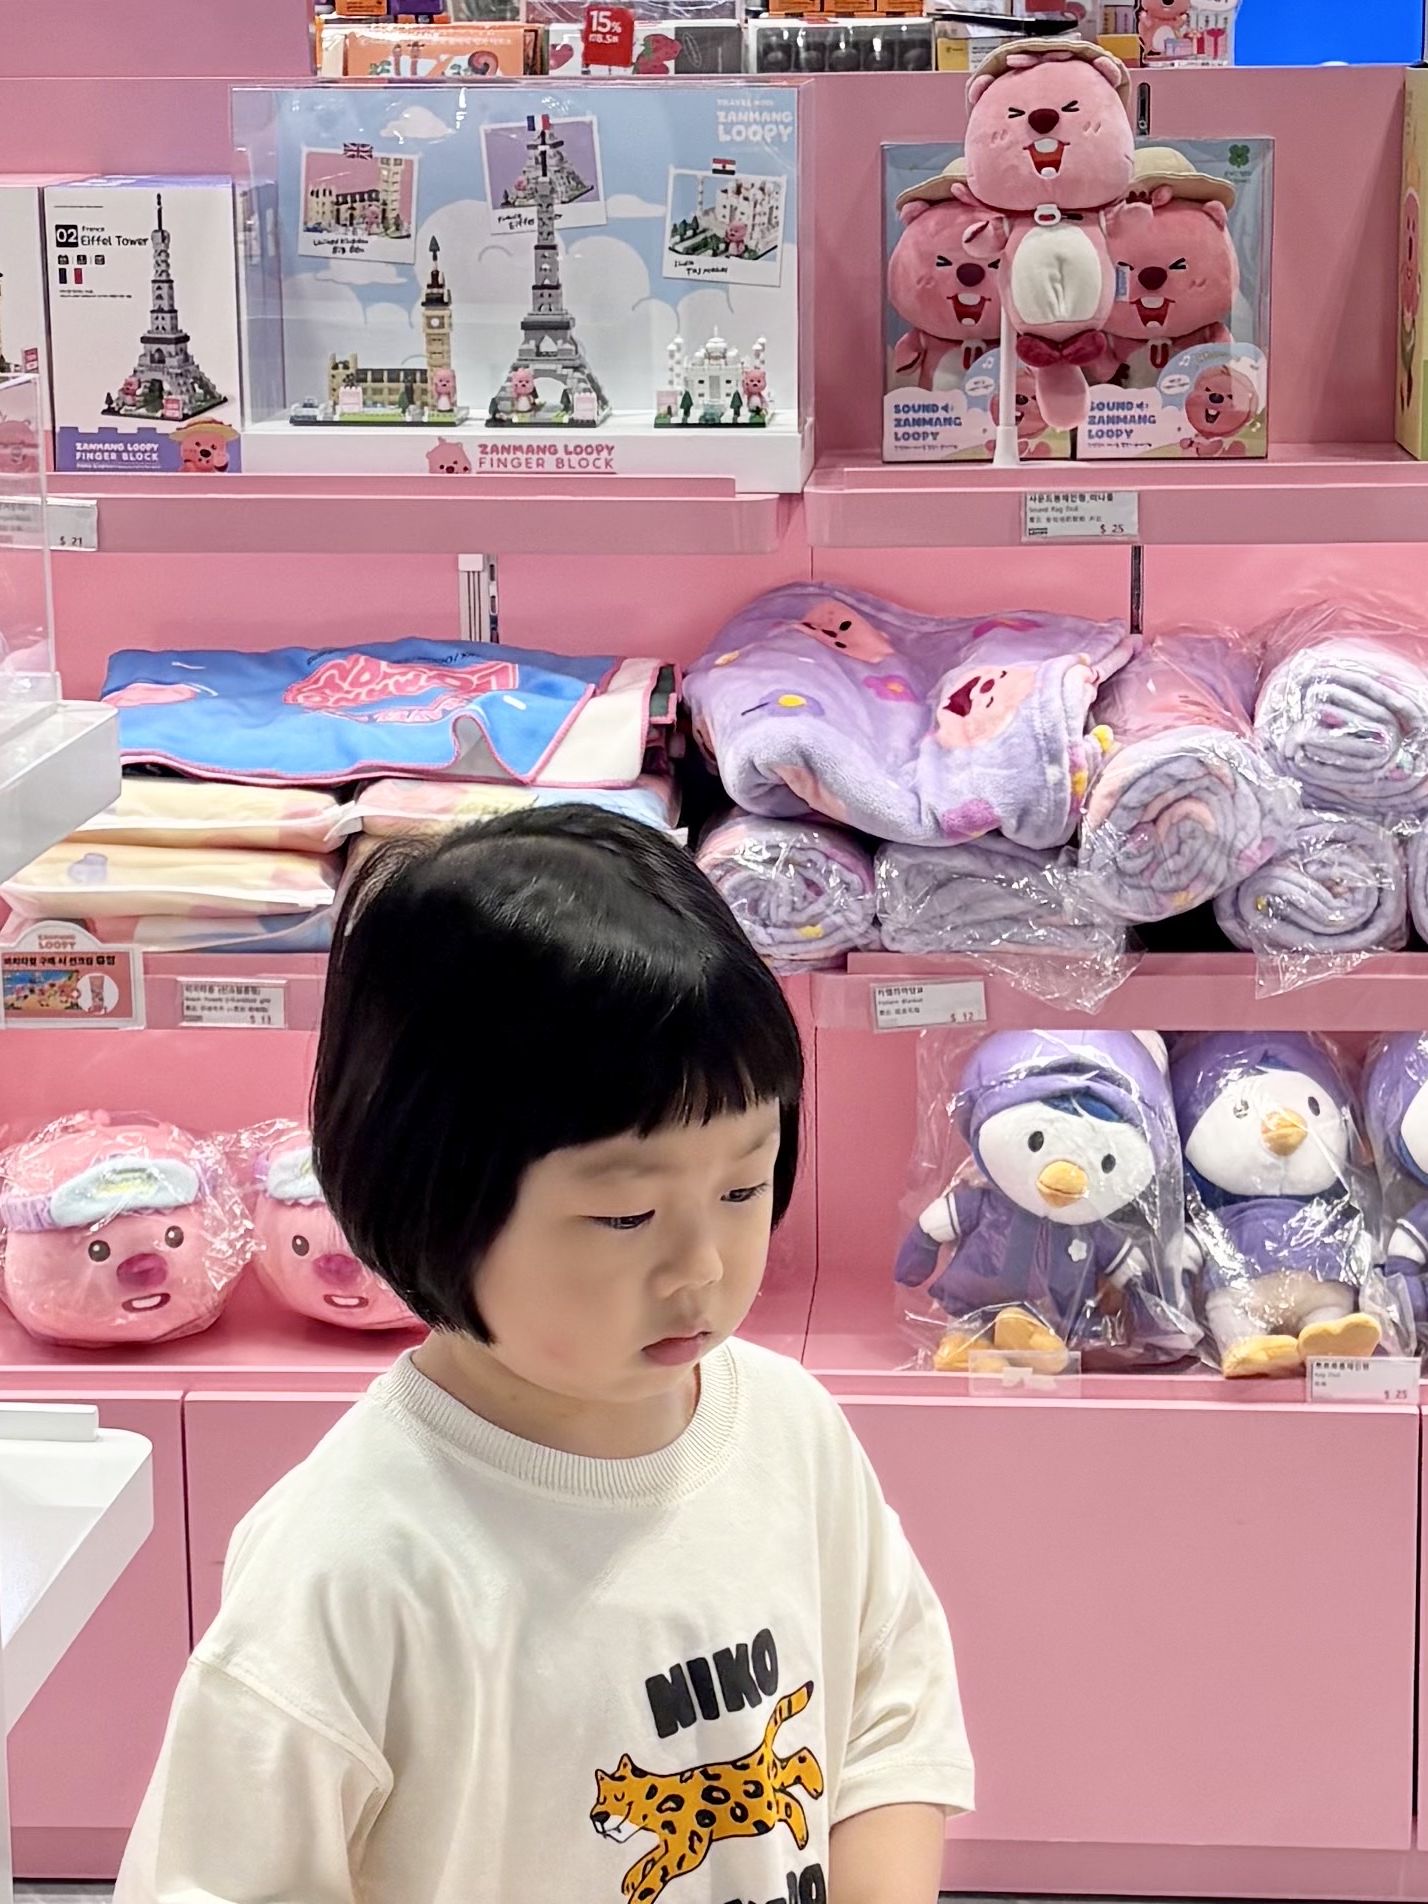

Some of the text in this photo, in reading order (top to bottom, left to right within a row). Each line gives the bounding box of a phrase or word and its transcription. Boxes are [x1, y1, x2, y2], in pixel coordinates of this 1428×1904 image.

[589, 10, 622, 34] 15%
[716, 110, 793, 125] ZANMANG
[717, 124, 793, 144] LOOPY
[56, 227, 78, 244] 02
[80, 234, 149, 247] Eiffel Tower
[893, 402, 939, 415] SOUND
[1088, 401, 1134, 413] SOUND
[893, 415, 963, 428] ZANMANG
[1087, 414, 1157, 426] ZANMANG
[893, 429, 940, 442] LOOPY
[1087, 427, 1134, 441] LOOPY
[75, 441, 159, 452] ZANMANG LOOPY
[477, 442, 615, 458] ZANMANG LOOPY
[75, 451, 159, 461] FINGER BLOCK
[477, 457, 615, 471] FINGER BLOCK
[1099, 523, 1125, 535] $ 25
[38, 940, 77, 951] LOOPY
[962, 1011, 975, 1022] 12
[645, 1627, 779, 1740] NIKO
